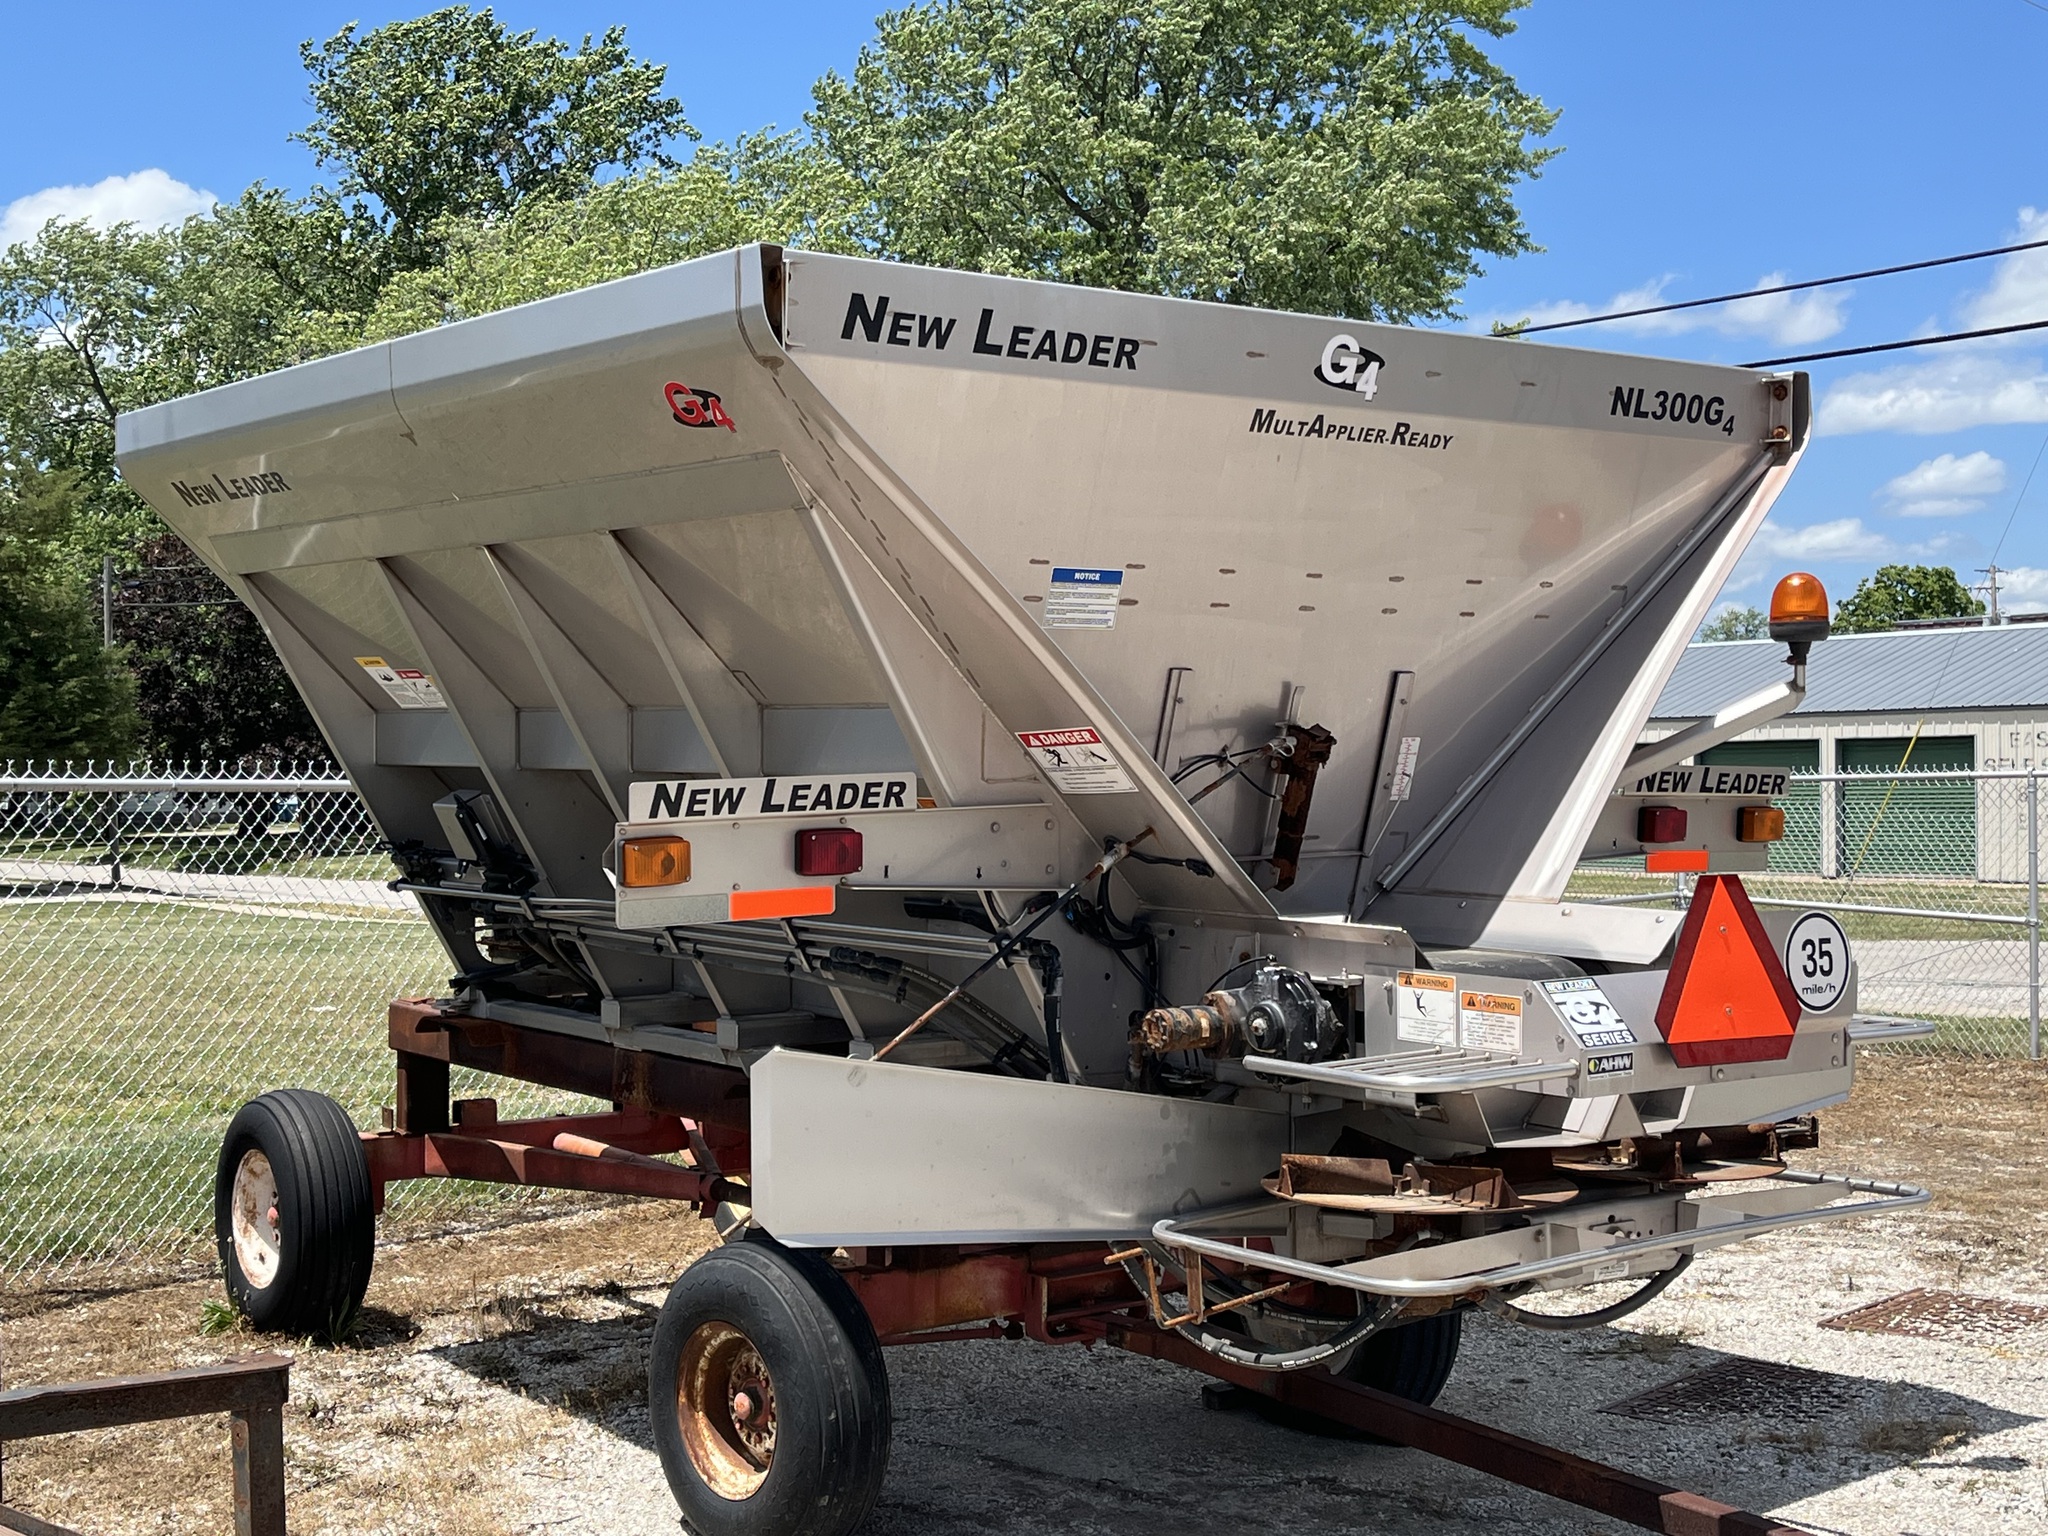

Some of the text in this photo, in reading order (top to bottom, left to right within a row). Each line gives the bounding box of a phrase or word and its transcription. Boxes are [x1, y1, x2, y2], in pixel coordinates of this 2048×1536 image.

[841, 292, 1140, 370] NEW LEADER
[1610, 386, 1735, 436] NL300G4
[170, 471, 292, 507] NEW LEADER
[1074, 571, 1101, 581] NOTICE
[1039, 730, 1095, 745] DANGER
[1699, 766, 1785, 795] LEADER
[649, 778, 907, 819] NEW LEADER
[1801, 937, 1834, 978] 35
[1415, 977, 1449, 988] WARNING
[1801, 983, 1836, 995] mile/h
[1581, 1030, 1634, 1048] SERIES
[1598, 1054, 1632, 1072] AHW
